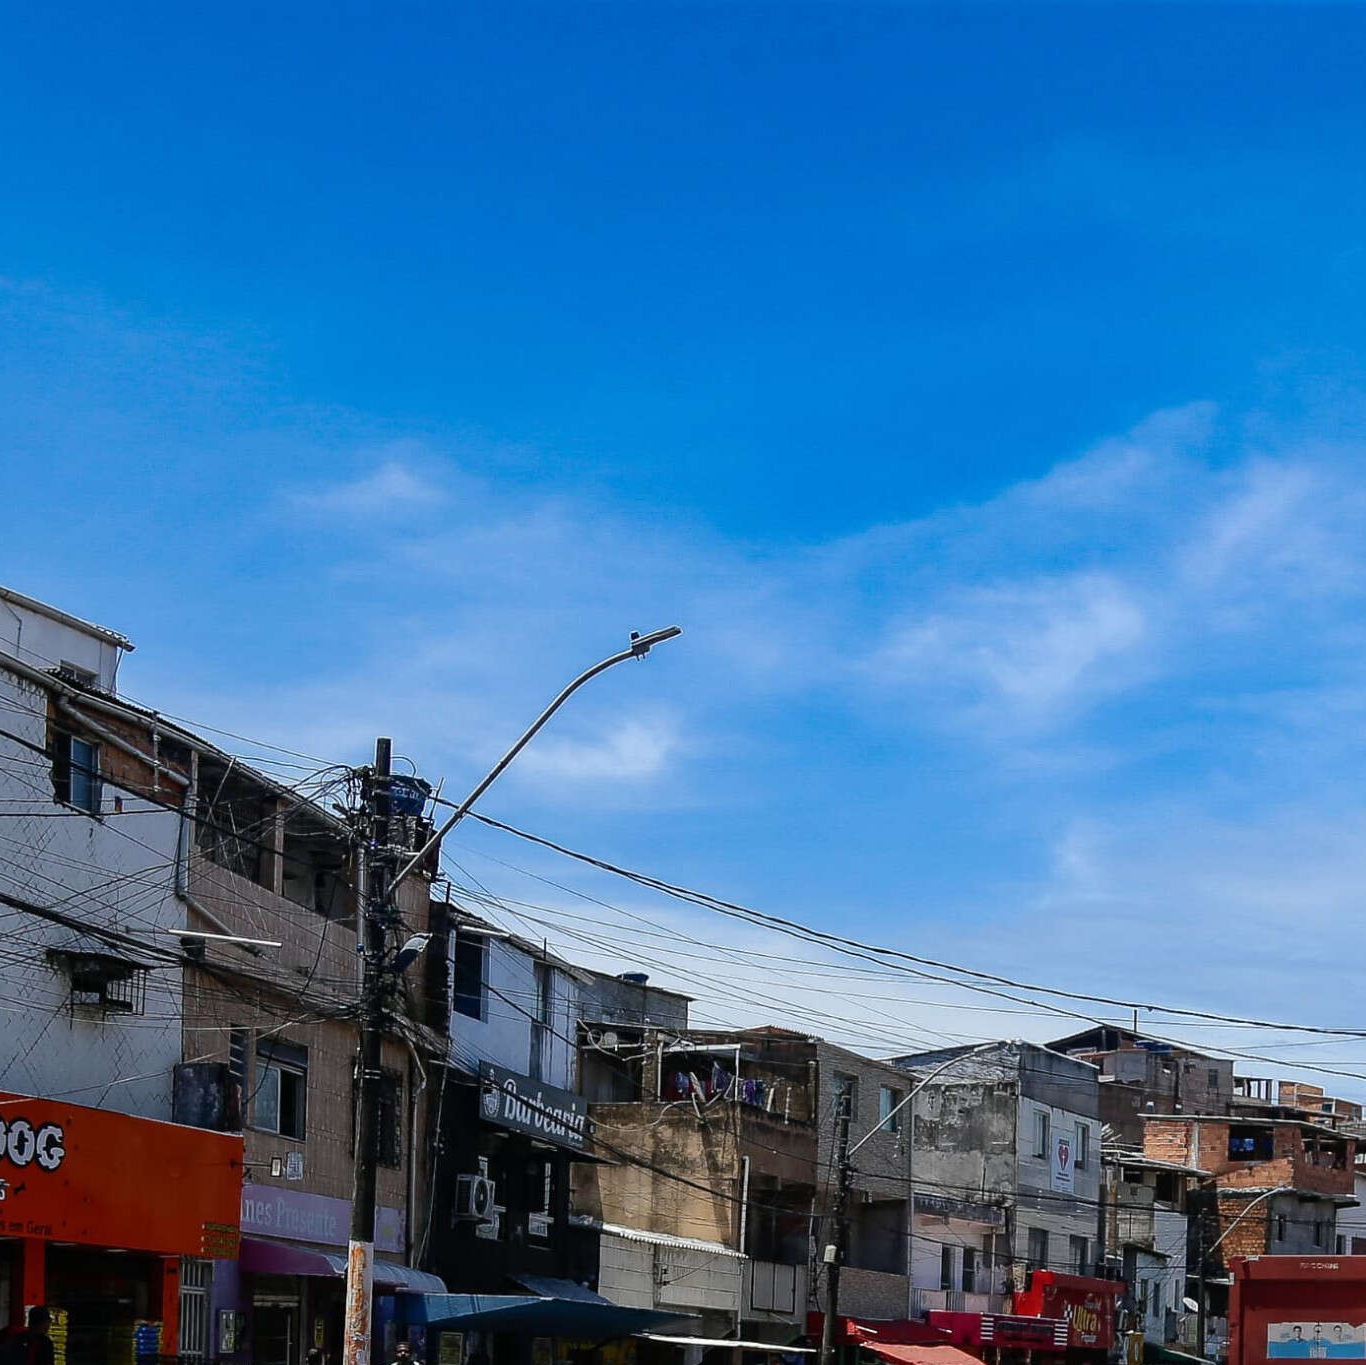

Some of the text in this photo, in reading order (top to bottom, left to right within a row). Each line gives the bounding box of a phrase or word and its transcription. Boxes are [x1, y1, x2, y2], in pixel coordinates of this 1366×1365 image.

[502, 1077, 585, 1142] Barbearia
[276, 1196, 337, 1239] Presente
[1073, 1303, 1098, 1331] Ultra
